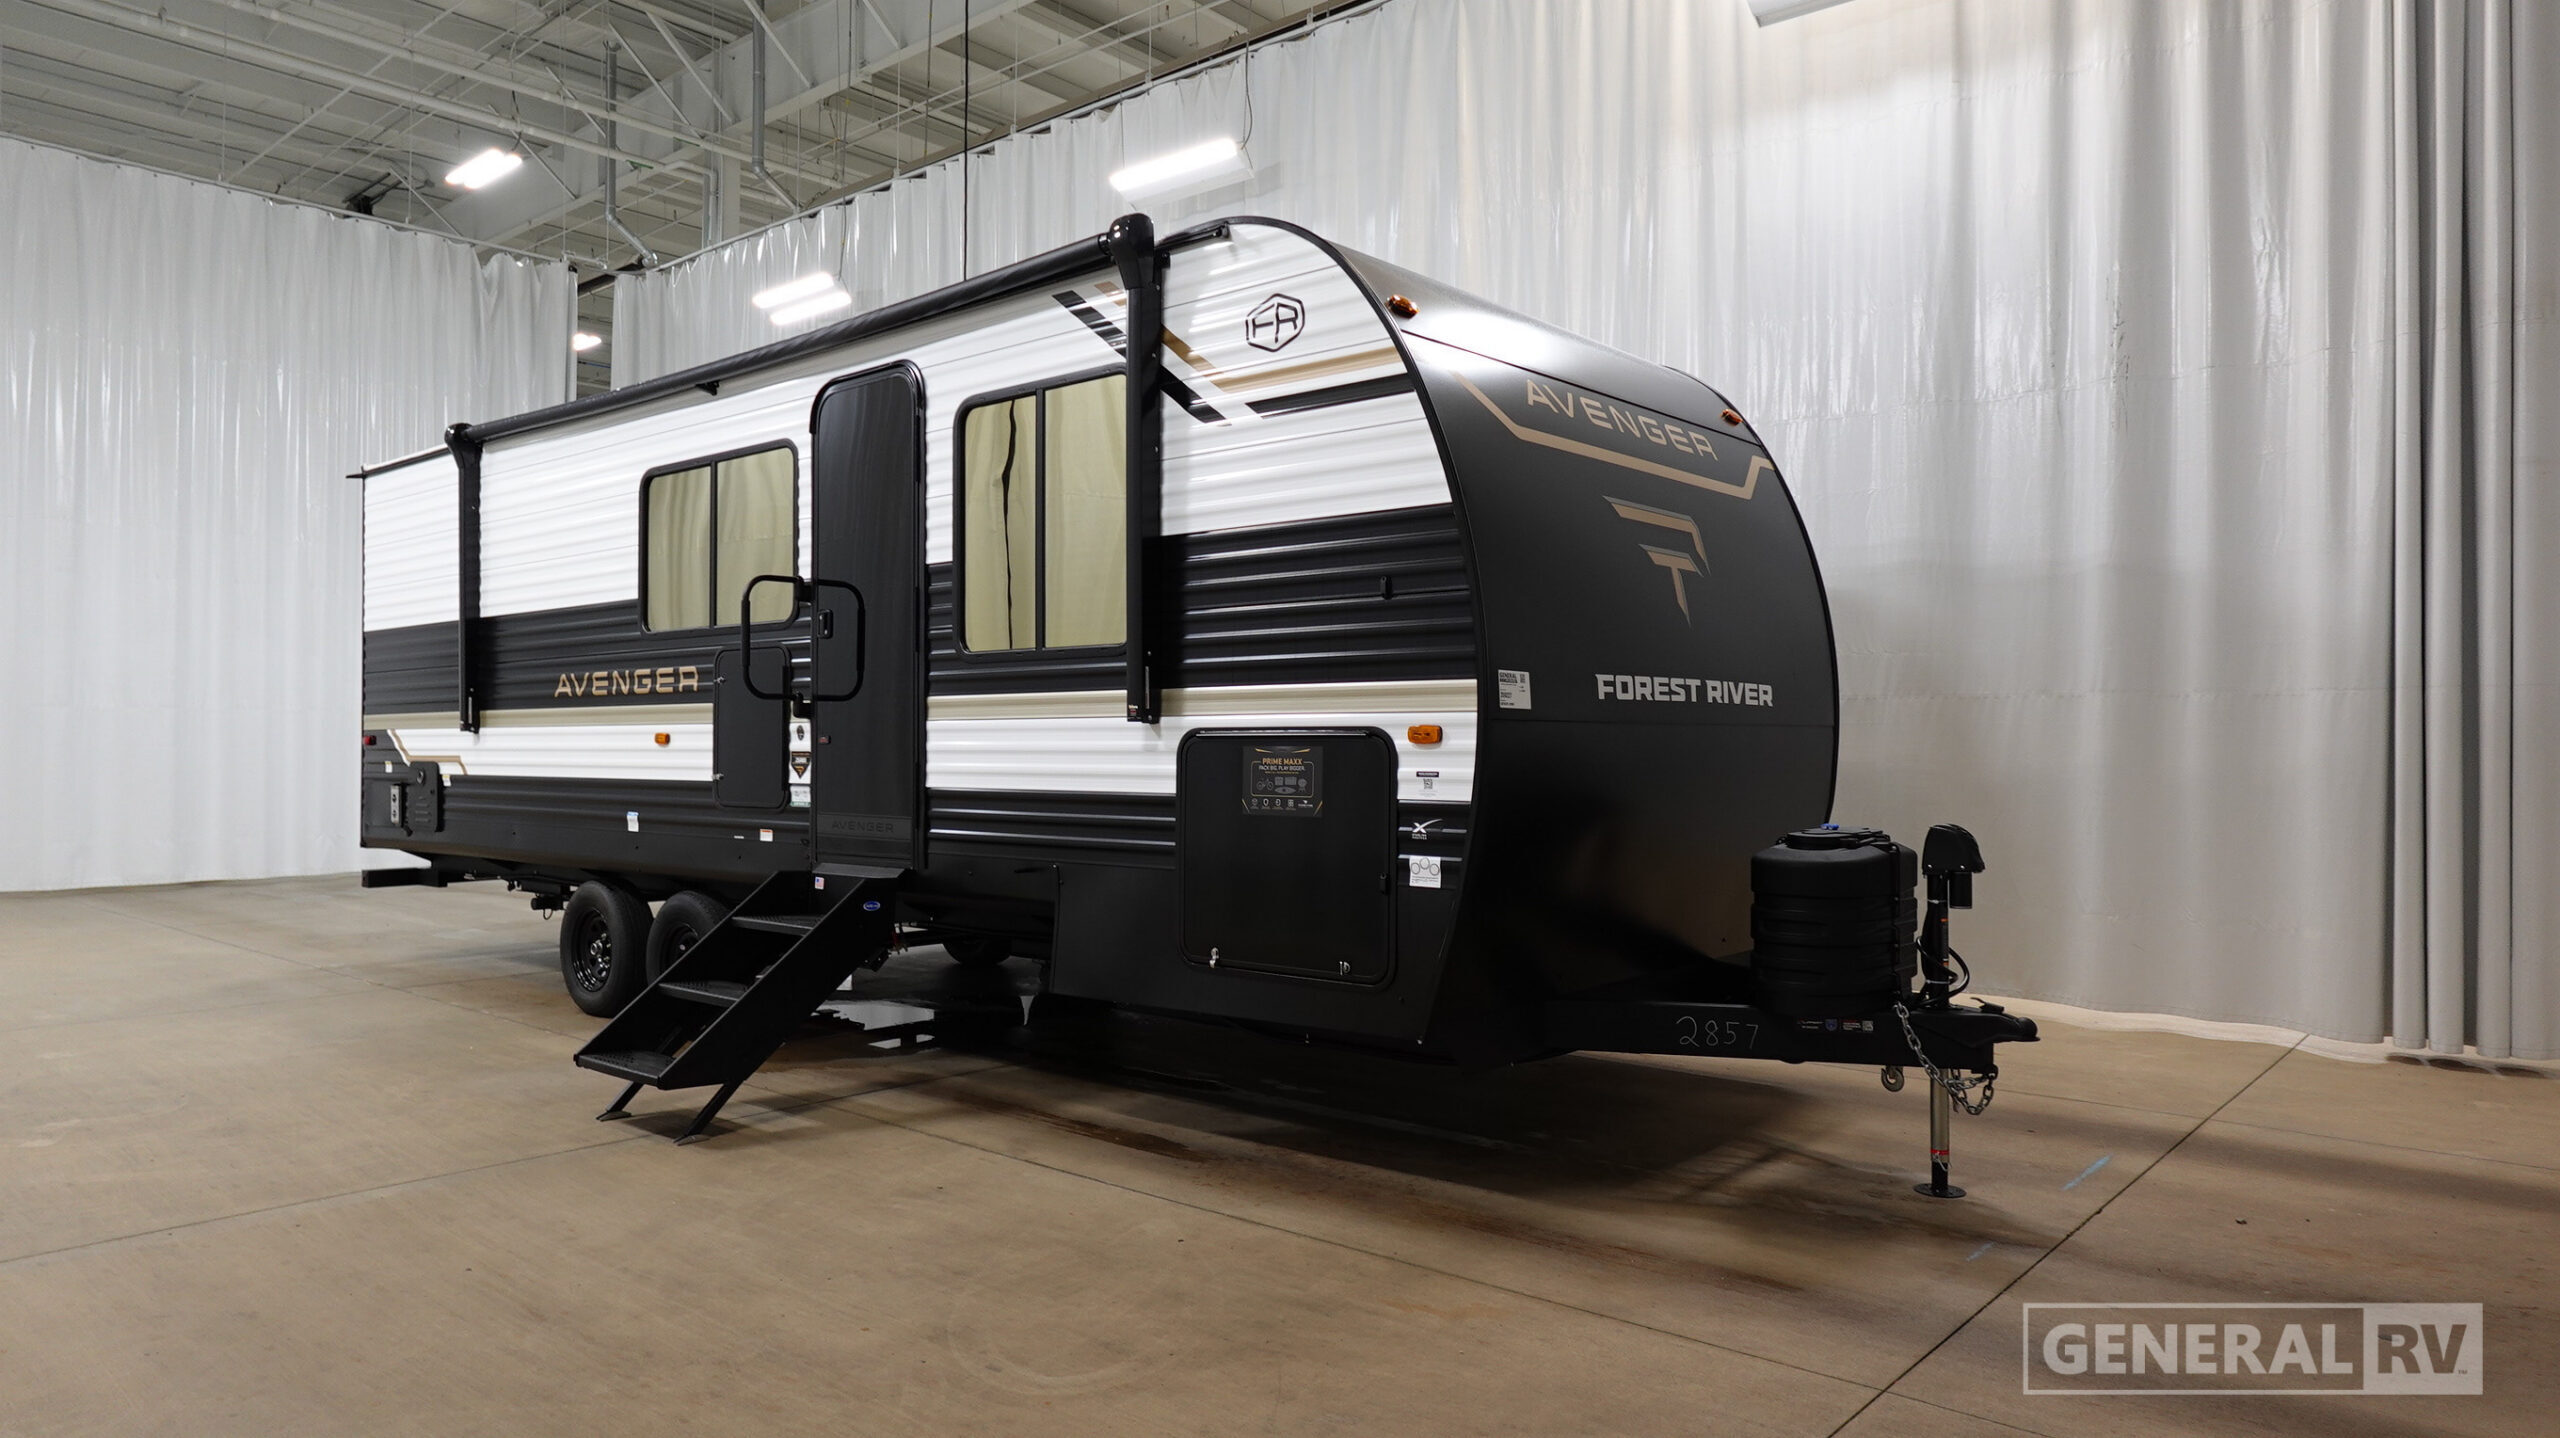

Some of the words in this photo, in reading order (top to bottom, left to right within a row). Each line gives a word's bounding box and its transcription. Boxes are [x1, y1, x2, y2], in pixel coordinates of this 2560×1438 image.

[1527, 379, 1718, 461] AVENGER
[554, 666, 699, 697] AVENGER
[1595, 674, 1701, 702] FOREST
[1705, 680, 1773, 707] RIVER
[1262, 757, 1283, 765] PRIME
[831, 819, 894, 833] AVENGER
[1676, 1016, 1759, 1049] 2857
